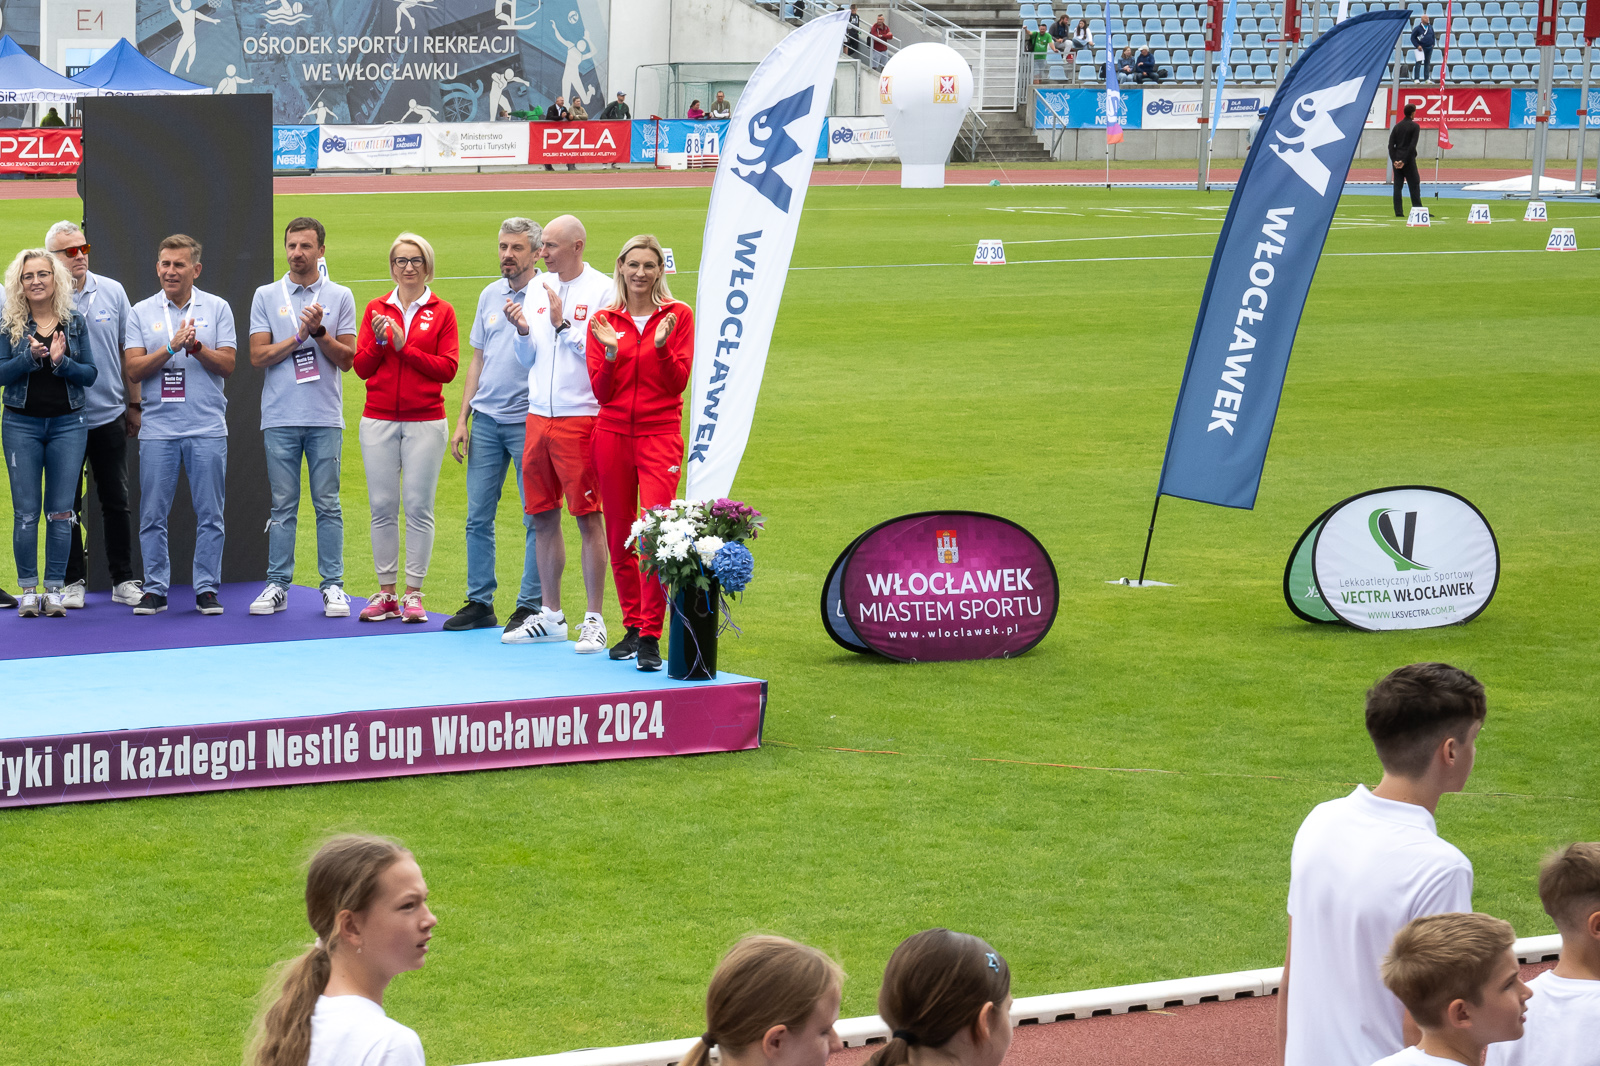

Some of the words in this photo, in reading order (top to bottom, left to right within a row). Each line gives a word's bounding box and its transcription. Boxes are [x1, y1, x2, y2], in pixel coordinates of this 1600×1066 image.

[77, 10, 104, 30] E1
[243, 32, 332, 54] OŚRODEK
[337, 36, 408, 54] SPORTU
[414, 36, 418, 53] I
[424, 35, 515, 54] REKREACJI
[302, 63, 331, 81] WE
[337, 62, 458, 81] WŁOCŁAWKU
[1404, 95, 1491, 114] PZLA
[1095, 115, 1127, 125] Nelé
[460, 142, 482, 151] Sportu
[488, 142, 516, 151] Turystyki
[543, 129, 616, 149] PZLA
[708, 138, 715, 153] 1
[277, 155, 306, 165] Nestlé
[1415, 213, 1428, 223] 16
[1476, 210, 1488, 219] 14
[1532, 207, 1545, 217] 12
[1549, 234, 1562, 246] 20
[1564, 235, 1575, 246] 20
[976, 247, 988, 259] 30
[991, 247, 1003, 259] 30
[1207, 206, 1295, 436] WŁOCŁAWEK
[687, 230, 763, 463] WŁOCŁAWEK
[866, 568, 1034, 596] WŁOCŁAWEK
[1339, 577, 1410, 588] Lekkoatletyczny
[1413, 573, 1432, 584] Klub
[1434, 570, 1474, 582] Sportowy
[1341, 589, 1391, 604] VECTRA
[1393, 582, 1475, 602] WŁOCŁAWEK
[860, 601, 954, 623] MIASTEM
[960, 596, 1041, 620] SPORTU
[1368, 605, 1456, 620] WWW.LKSVECTRA.COM.PL
[889, 624, 1018, 639] www.wloclawek.pl
[63, 743, 110, 785] dla
[119, 730, 256, 781] każdego!
[266, 722, 360, 769] Nestlé
[368, 720, 423, 765] Cup
[431, 706, 589, 757] Włocławek
[597, 700, 665, 744] 2024
